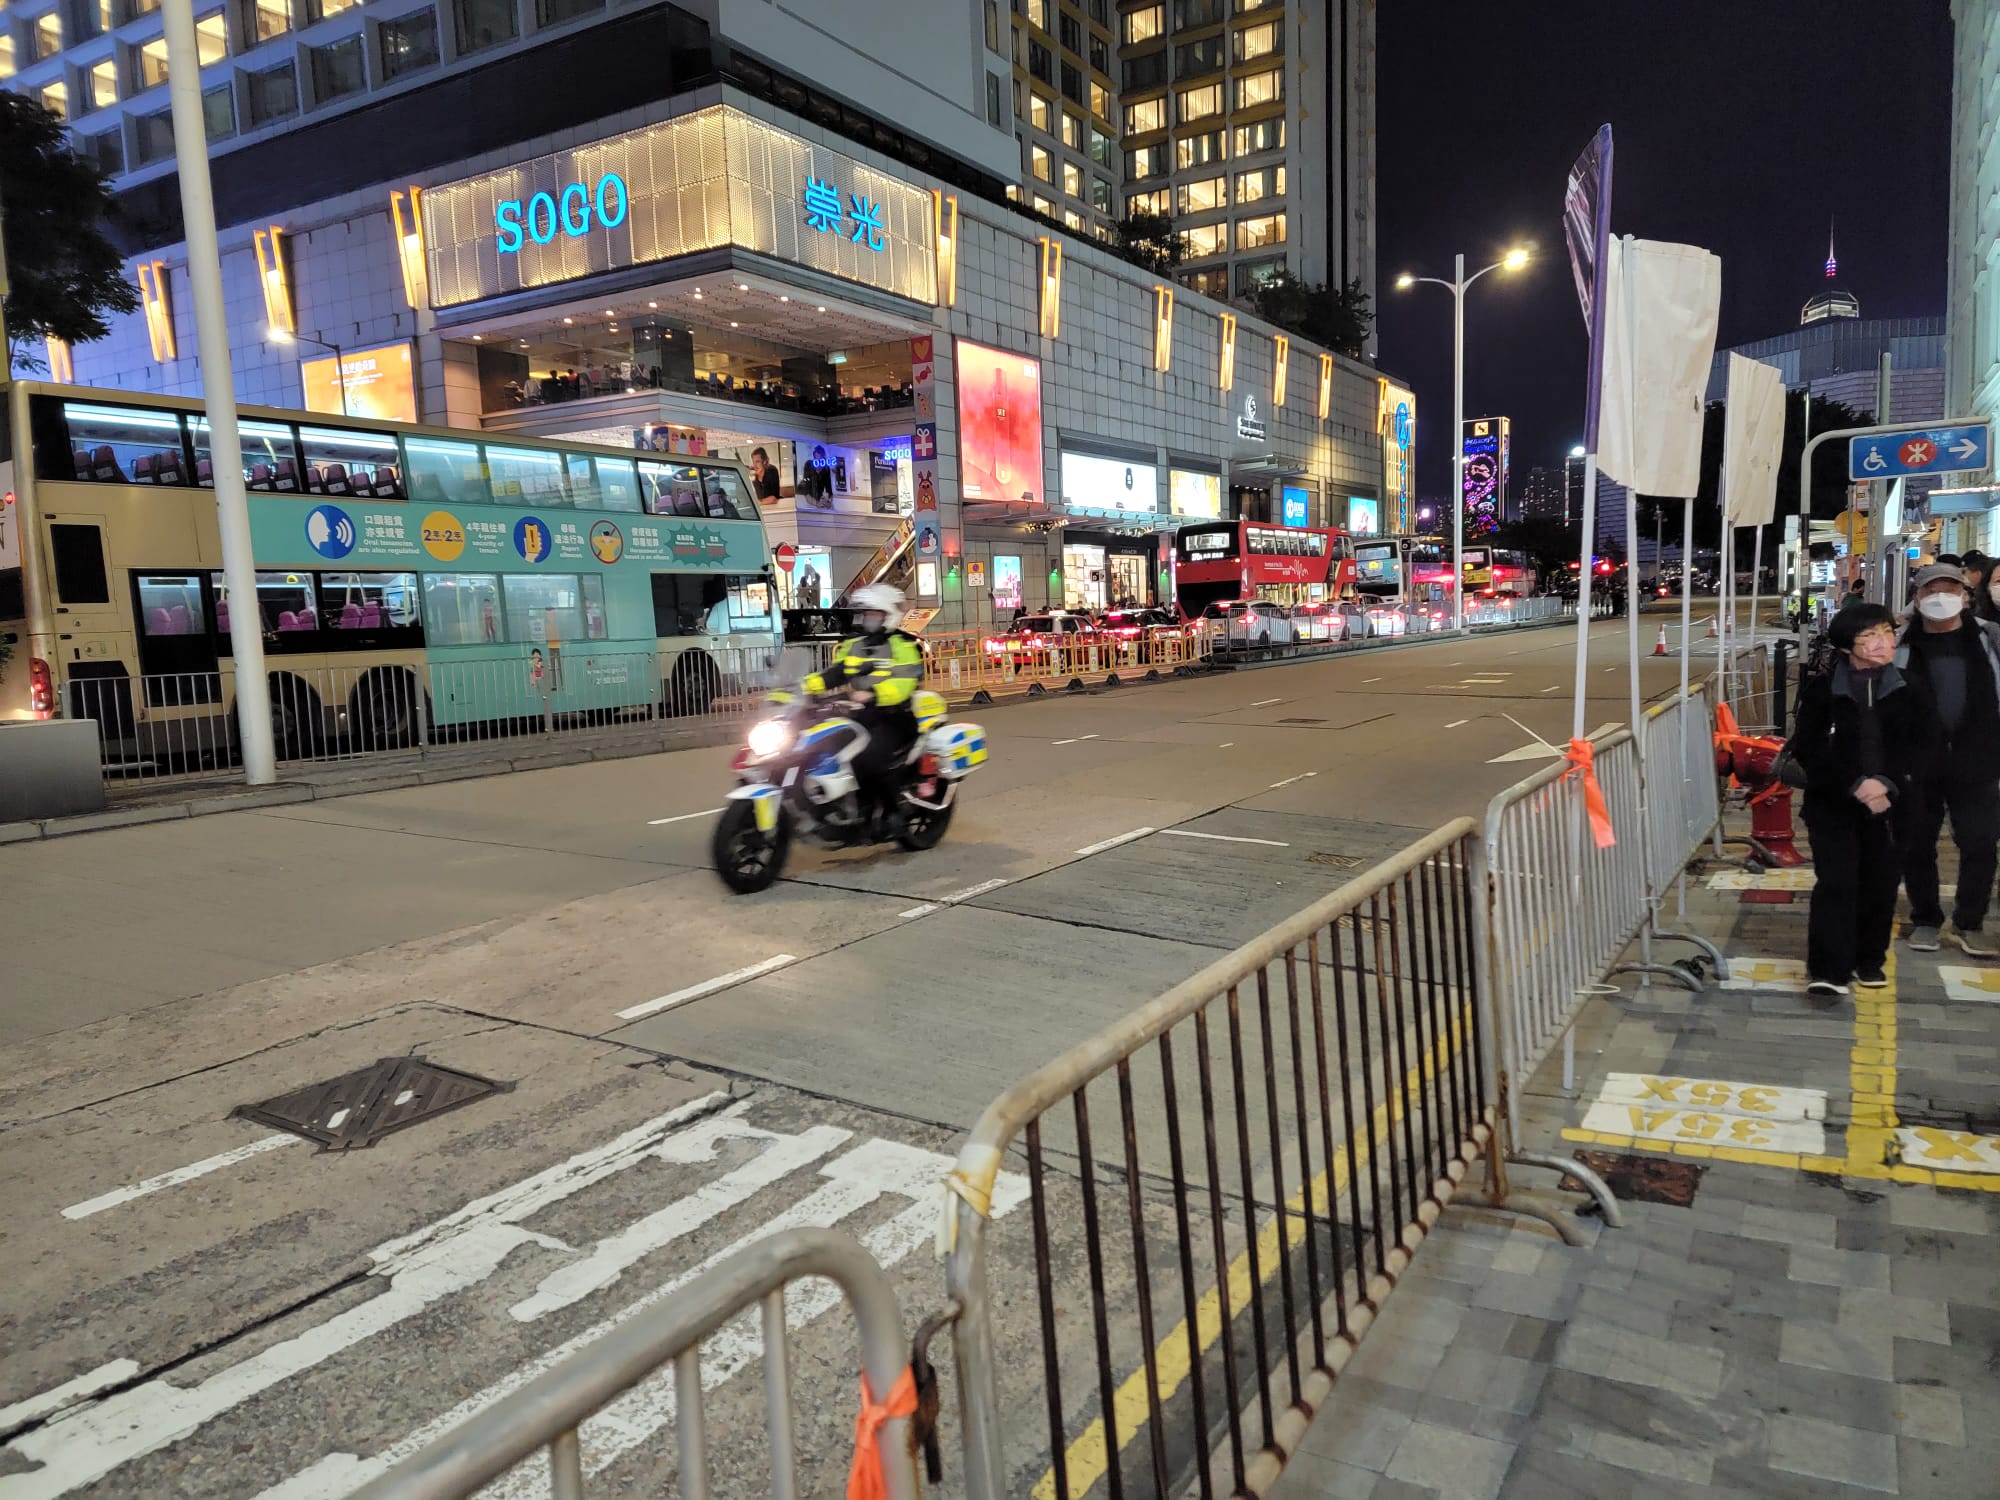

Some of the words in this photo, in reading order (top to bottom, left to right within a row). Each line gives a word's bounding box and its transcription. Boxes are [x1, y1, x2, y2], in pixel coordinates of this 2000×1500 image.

[495, 172, 628, 254] SOGO
[804, 175, 885, 253] 崇光
[1634, 1076, 1781, 1114] 35X
[1627, 1105, 1778, 1146] 35A
